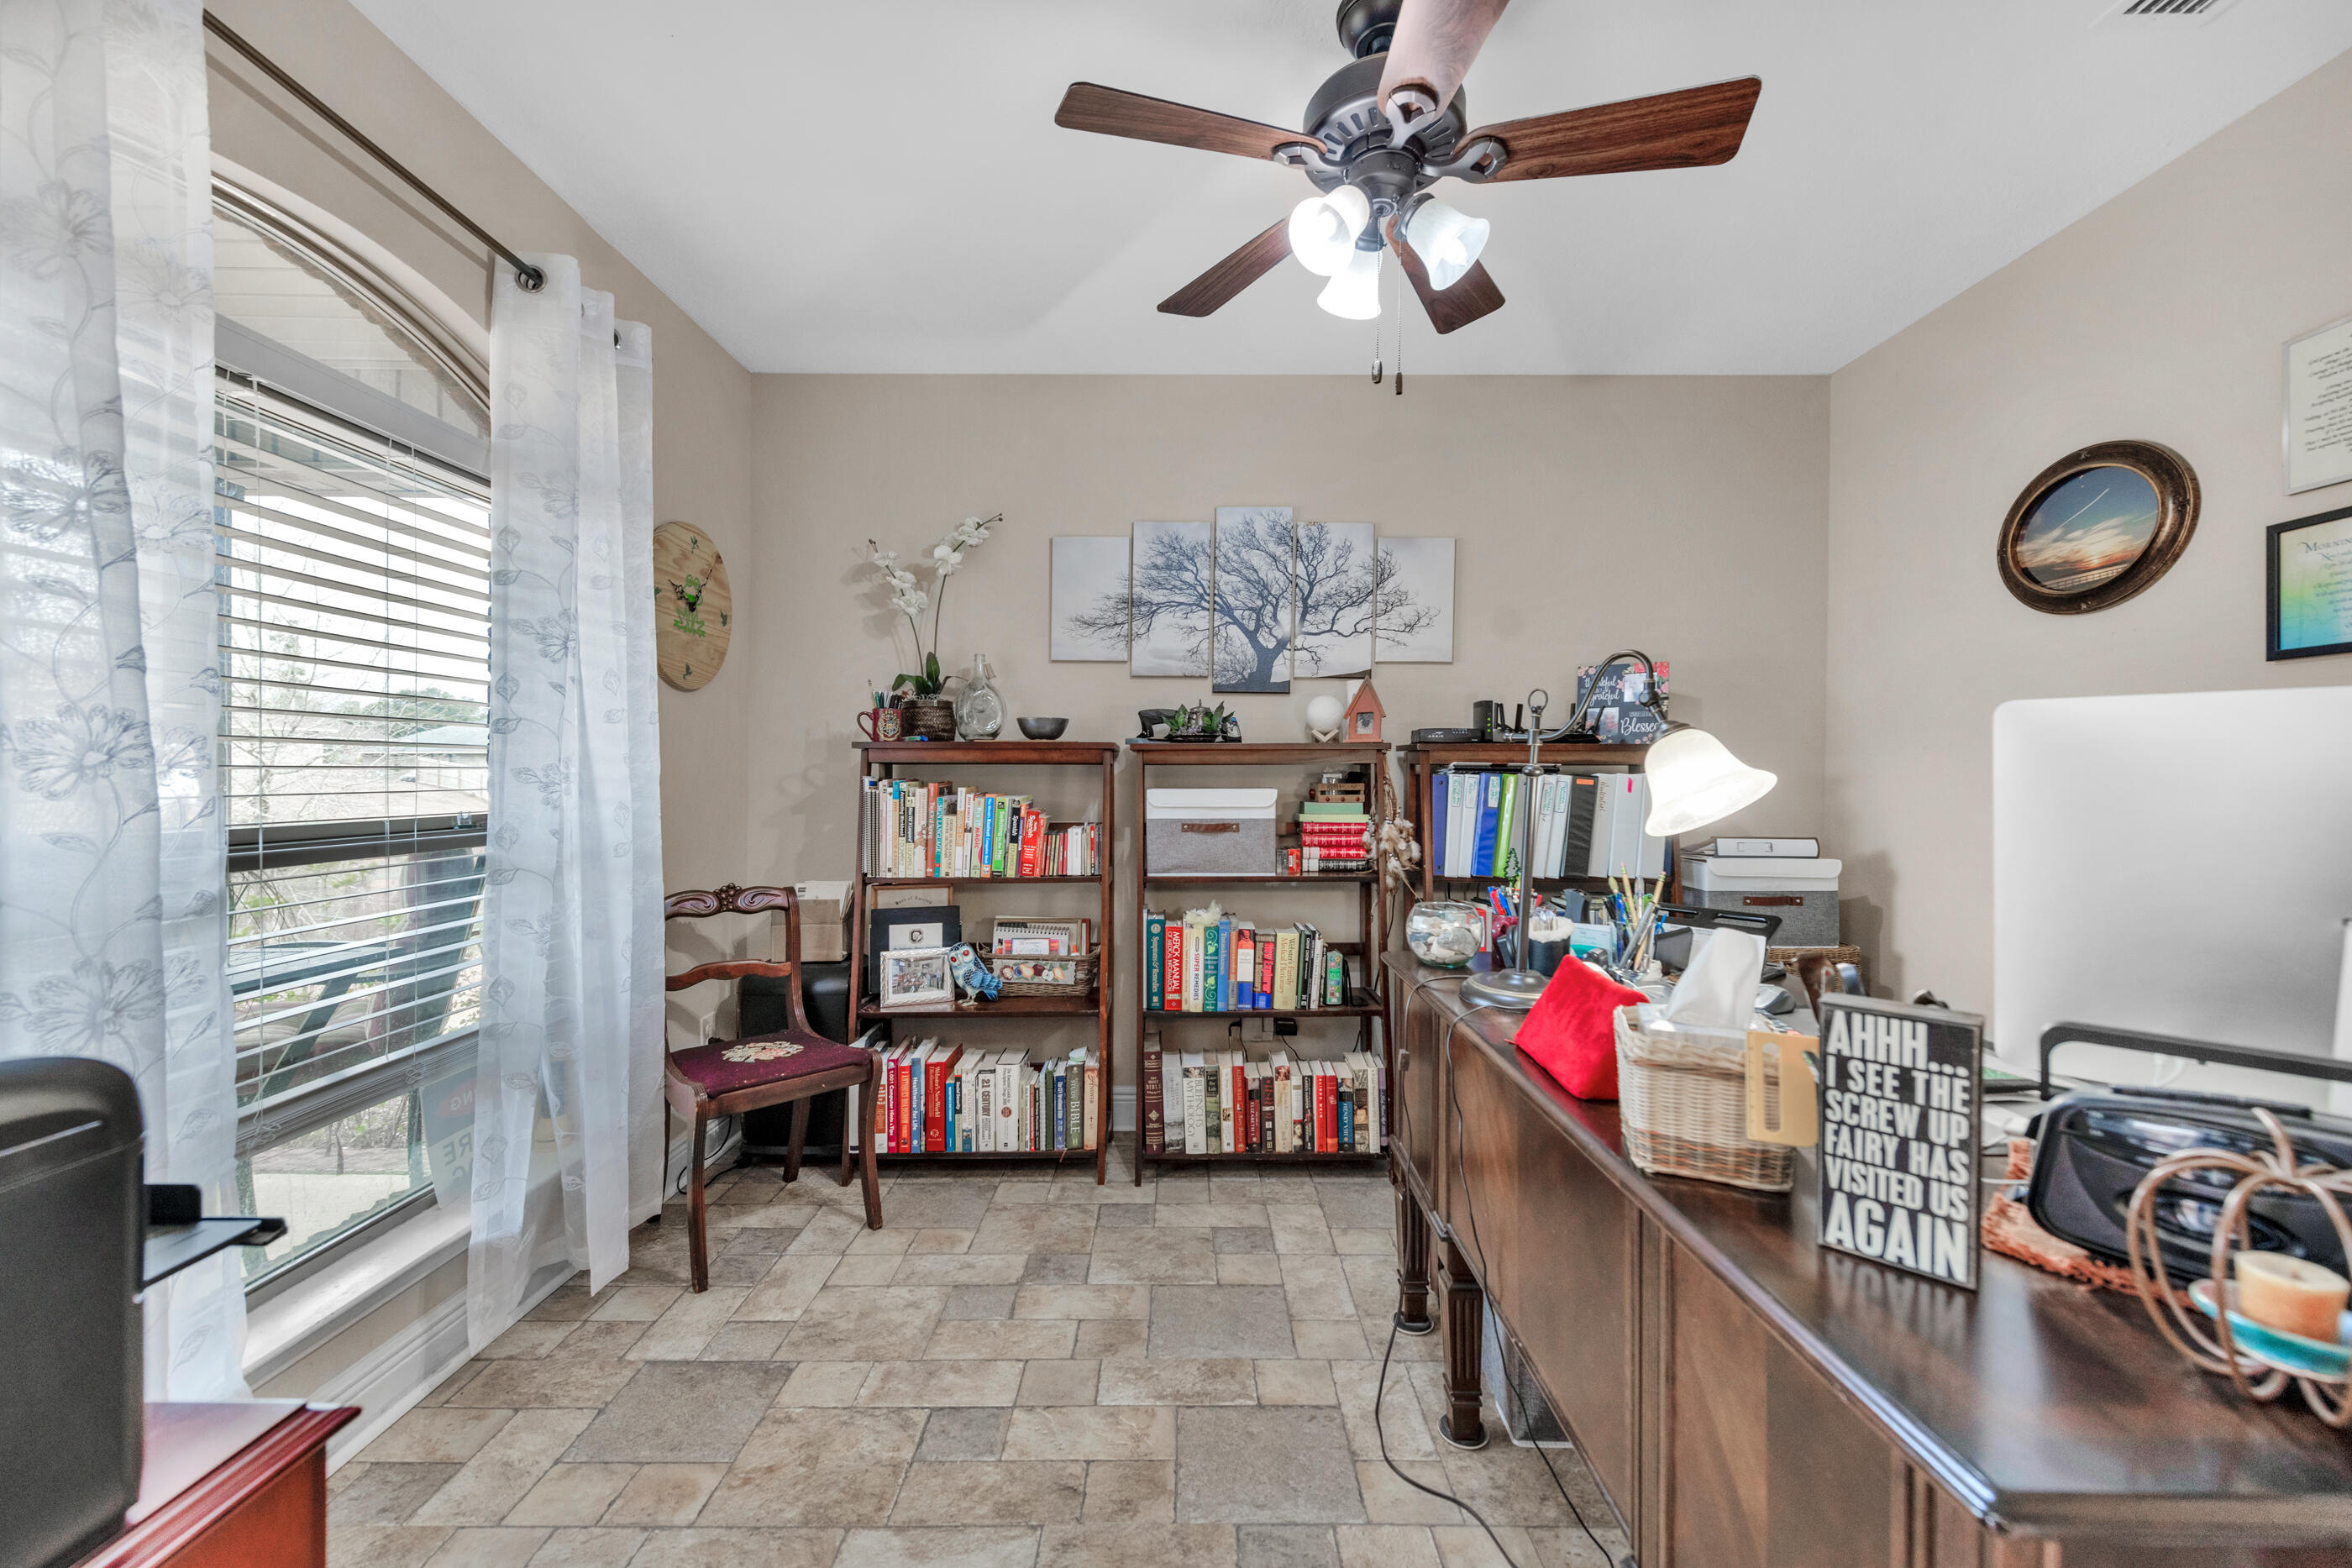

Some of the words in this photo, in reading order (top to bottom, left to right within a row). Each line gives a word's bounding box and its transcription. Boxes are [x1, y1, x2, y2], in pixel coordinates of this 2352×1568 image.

[1585, 675, 1618, 693] thnkful
[1590, 689, 1620, 706] grateful
[997, 810, 1005, 836] Switching
[1026, 814, 1037, 839] Spanish
[1151, 936, 1160, 961] Symptoms
[1280, 938, 1289, 962] Medical
[1288, 938, 1296, 964] Webster's
[1172, 958, 1180, 992] MANUAL
[1278, 962, 1288, 994] Dictionary
[1287, 966, 1295, 987] Family
[1826, 1009, 1970, 1078] AHHH...
[927, 1066, 935, 1093] Dictionary
[1825, 1054, 1837, 1088] I
[1847, 1059, 1901, 1102] SEE
[1911, 1070, 1971, 1114] THE
[981, 1090, 991, 1117] CENTURY
[1070, 1100, 1081, 1134] BIBLE
[1186, 1079, 1196, 1138] MYTHOLOGY
[1195, 1079, 1205, 1128] BULFINCH'S
[1824, 1088, 1921, 1140] SCREW
[1928, 1109, 1970, 1148] UP
[1824, 1121, 1901, 1169] FAIRY
[1908, 1141, 1969, 1186] HAS
[1824, 1154, 1924, 1211] VISITED
[1929, 1179, 1969, 1223] US
[1824, 1191, 1968, 1283] AGAIN
